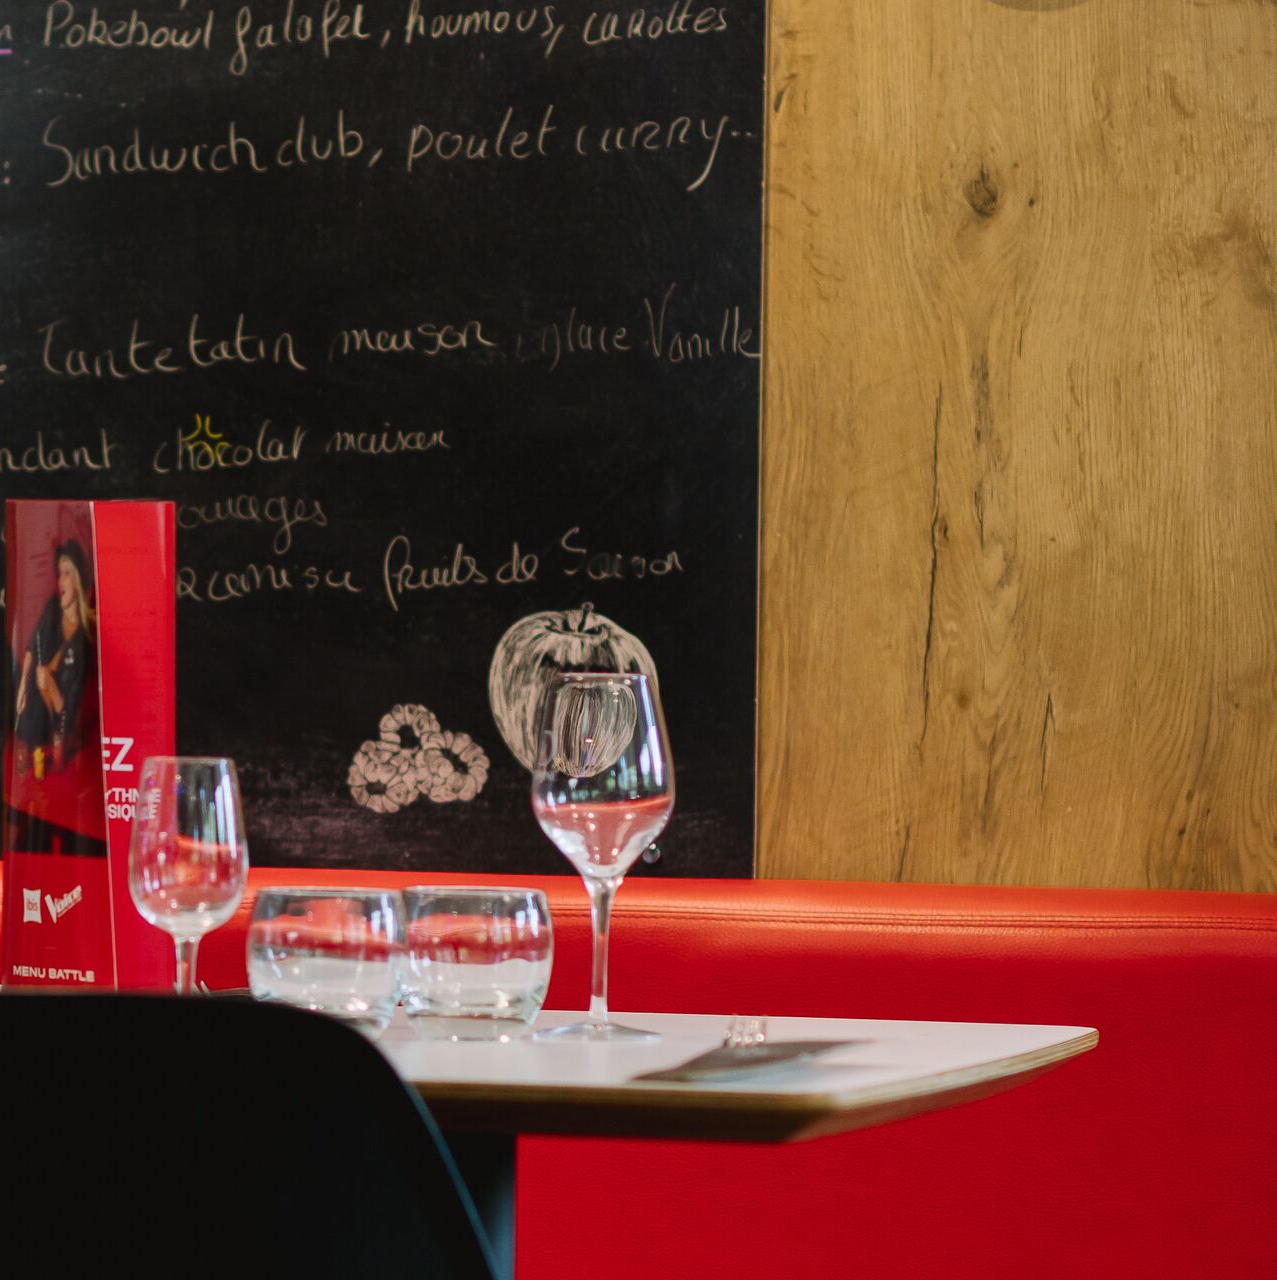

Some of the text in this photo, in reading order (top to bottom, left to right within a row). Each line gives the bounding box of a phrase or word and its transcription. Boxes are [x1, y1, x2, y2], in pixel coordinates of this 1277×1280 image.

[43, 0, 215, 50] Pokebowl
[43, 114, 270, 187] Sandwich
[275, 109, 384, 167] club,
[409, 103, 558, 171] poulet
[328, 320, 498, 362] maison
[493, 542, 540, 588] de
[12, 964, 96, 983] MENU BATTLE
